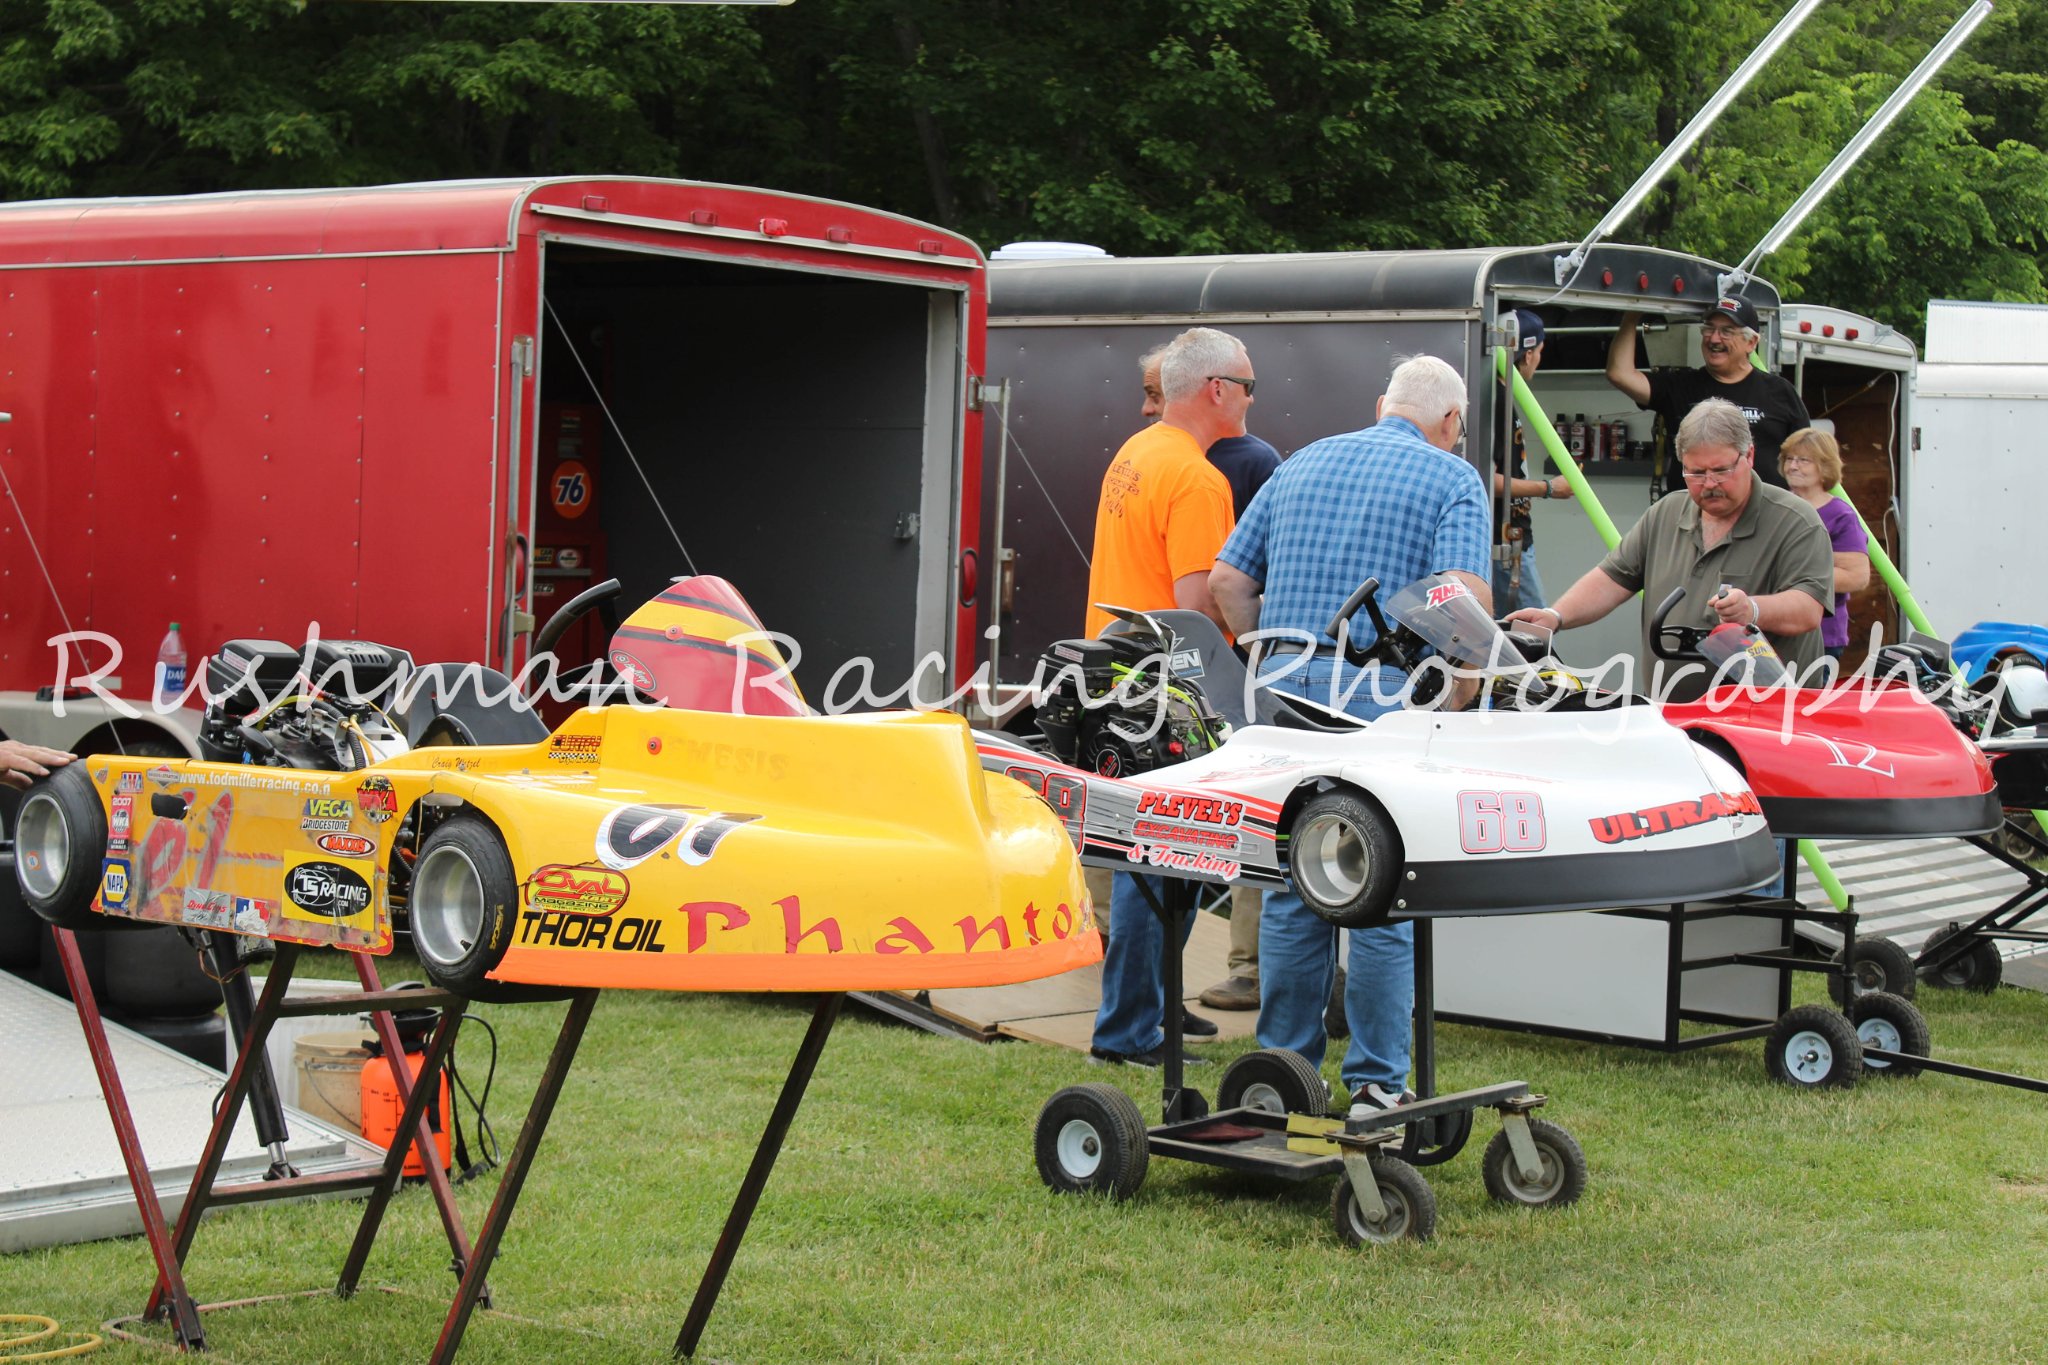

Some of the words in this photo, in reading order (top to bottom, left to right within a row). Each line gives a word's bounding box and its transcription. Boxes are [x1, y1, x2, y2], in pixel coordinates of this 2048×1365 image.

[555, 472, 586, 505] 76
[1797, 731, 1895, 778] 12
[112, 797, 132, 806] 2007
[308, 799, 353, 818] VEGA
[1136, 791, 1244, 827] PLEVEL'S
[302, 818, 349, 831] BRIDGESTONE
[1457, 789, 1547, 855] 68
[326, 835, 366, 852] MAXXIS
[1132, 820, 1240, 850] EXCAVATING
[1127, 844, 1143, 861] &
[106, 873, 125, 893] NAPA
[320, 881, 368, 903] RACING
[536, 870, 623, 895] OVAL
[522, 911, 613, 949] THOR
[614, 917, 666, 953] OIL
[678, 895, 1093, 955] Phanto
